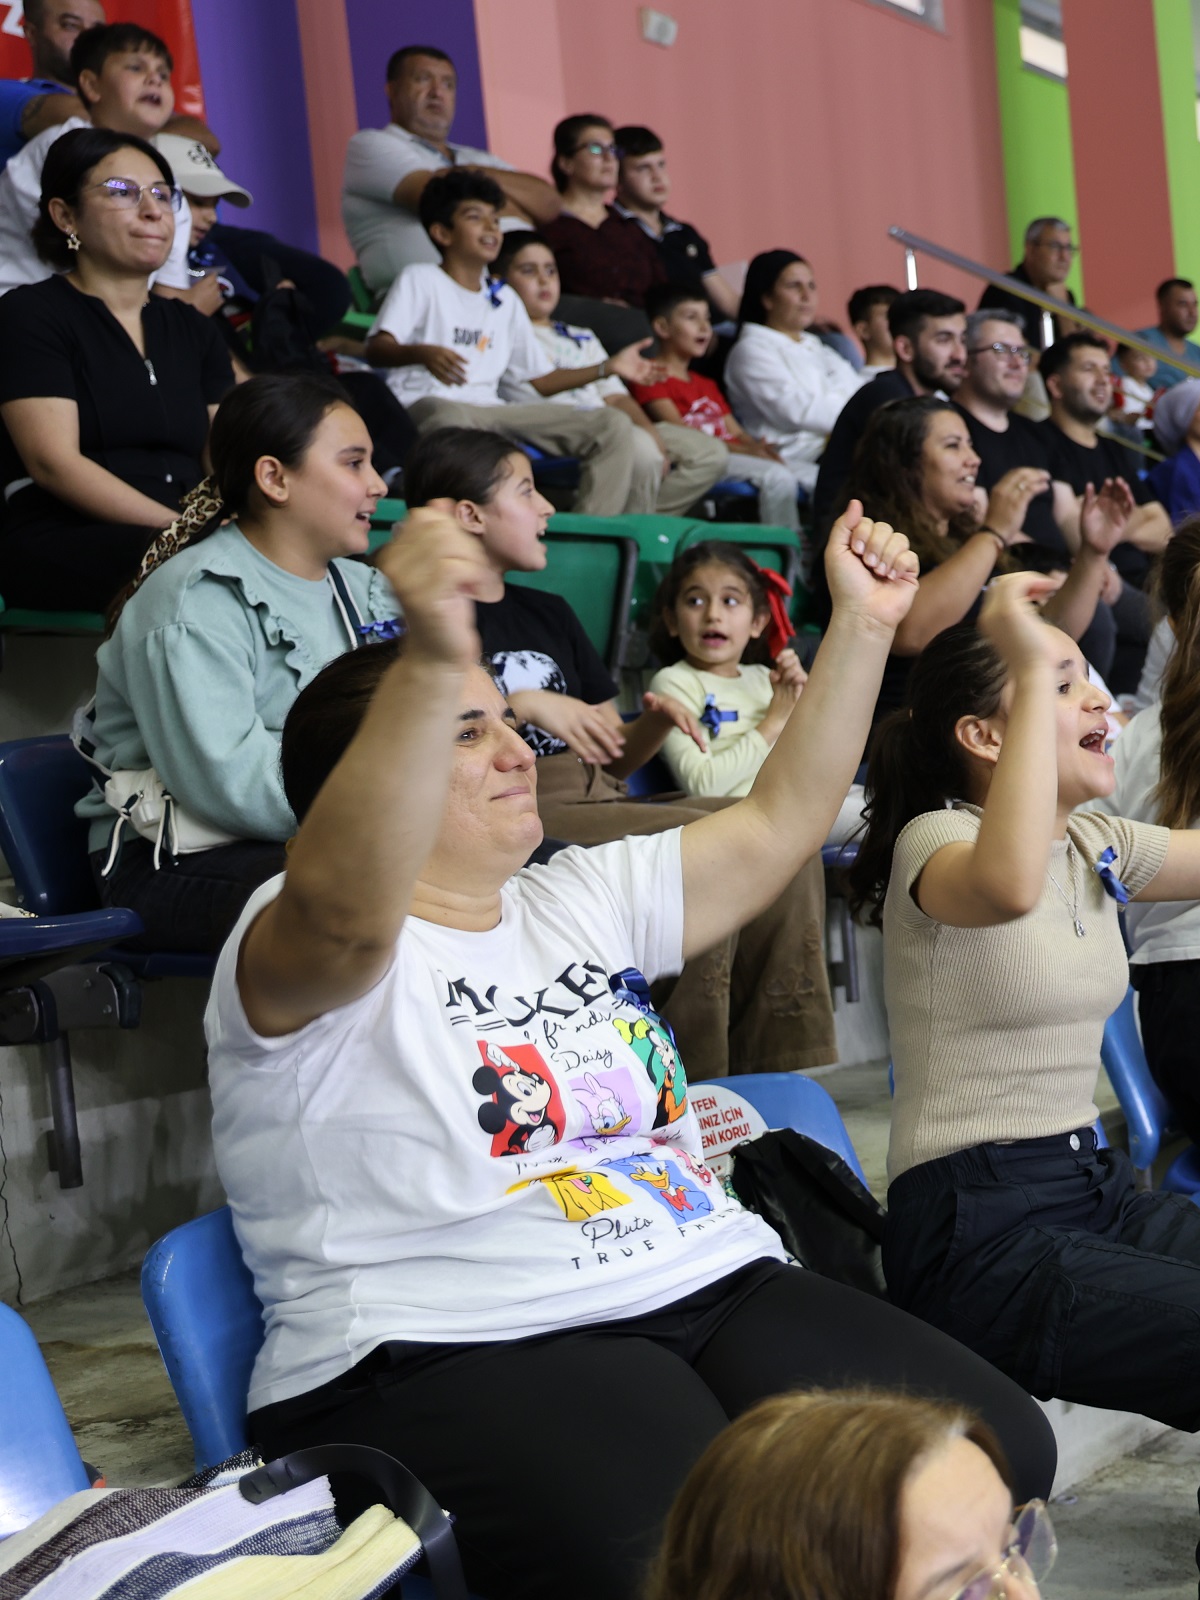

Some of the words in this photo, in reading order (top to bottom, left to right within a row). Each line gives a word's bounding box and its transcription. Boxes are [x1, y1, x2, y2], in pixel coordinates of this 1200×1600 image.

[550, 1047, 613, 1072] Daisy
[698, 1113, 721, 1131] INIZ
[720, 1106, 744, 1125] İÇİN
[717, 1122, 752, 1144] KORU!
[581, 1217, 653, 1249] Pluto
[571, 1239, 655, 1270] TRUE
